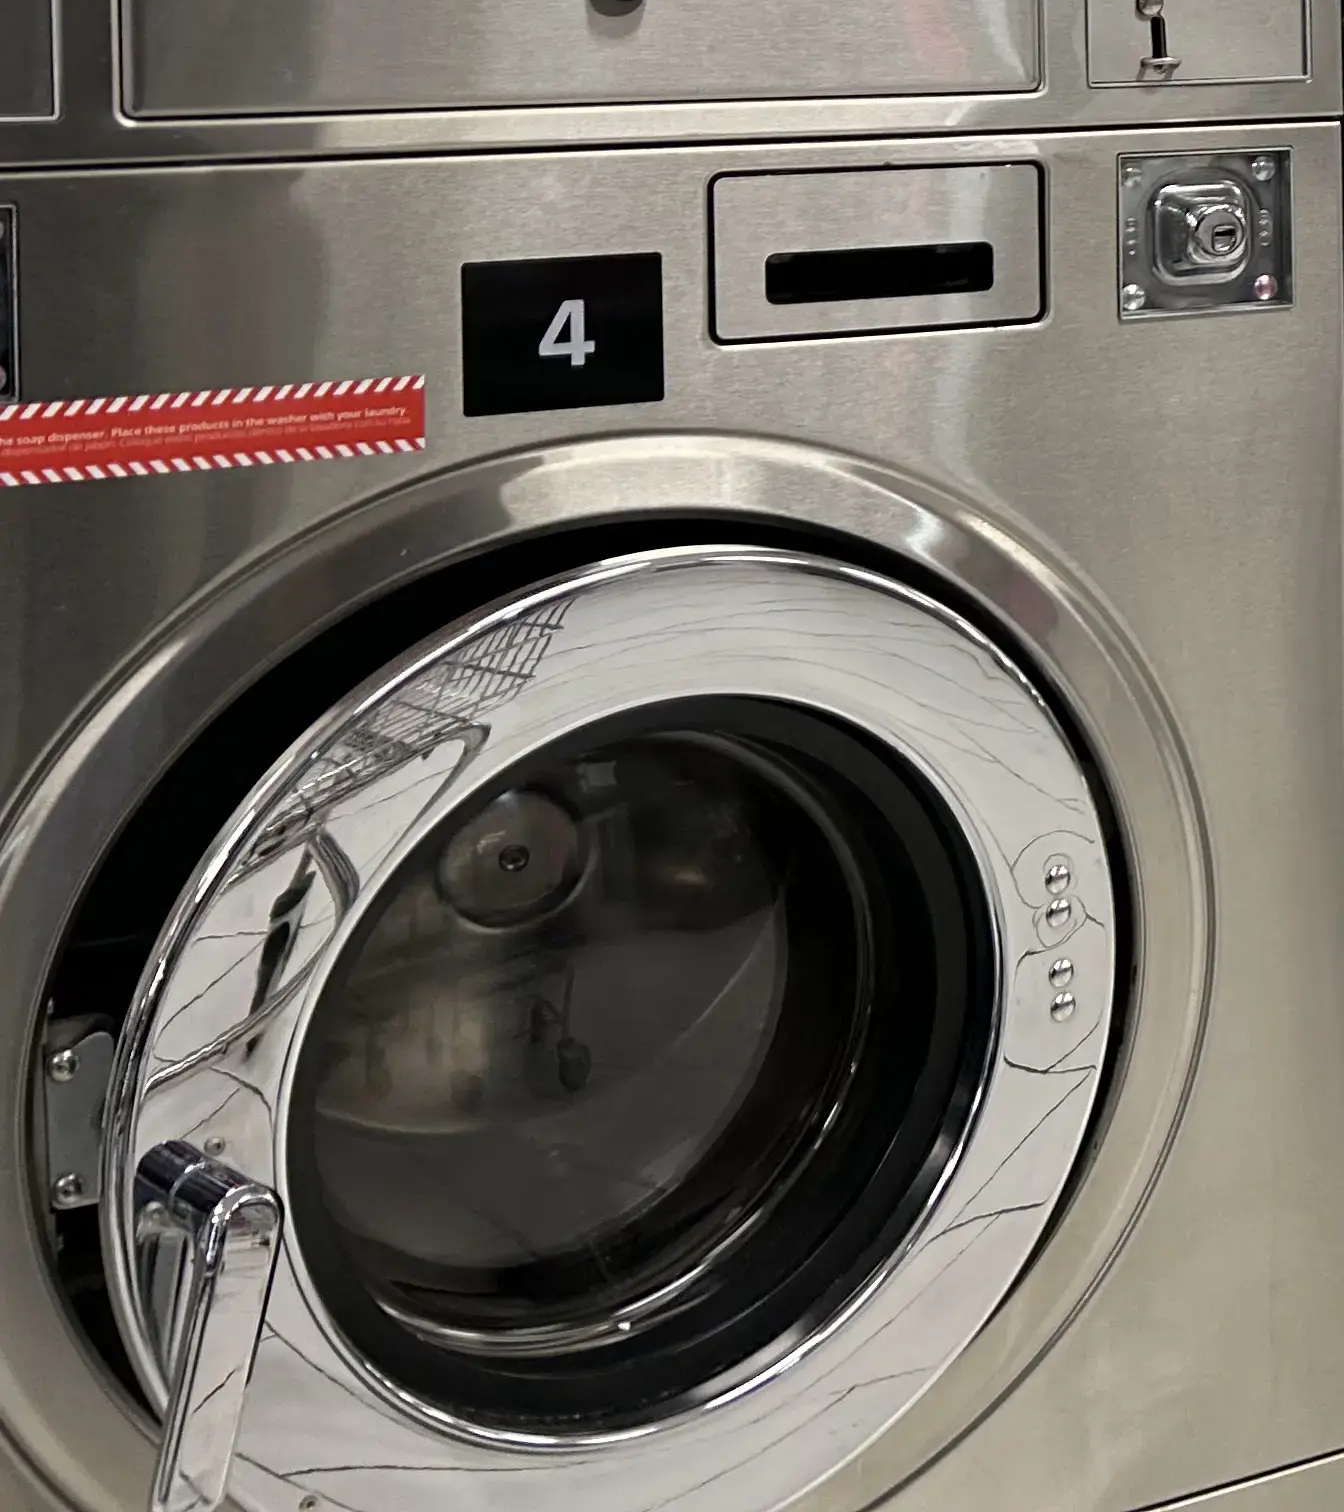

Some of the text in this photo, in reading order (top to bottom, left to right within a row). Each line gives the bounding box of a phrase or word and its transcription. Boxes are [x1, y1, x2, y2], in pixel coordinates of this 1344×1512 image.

[538, 298, 596, 368] 4
[0, 437, 13, 446] he
[17, 435, 45, 447] soap
[111, 427, 141, 437] Place
[144, 425, 176, 435] these
[179, 419, 229, 435] products
[232, 419, 243, 428] in
[245, 416, 265, 427] the
[267, 412, 307, 425] washer
[309, 411, 334, 421] with
[337, 410, 362, 422] your
